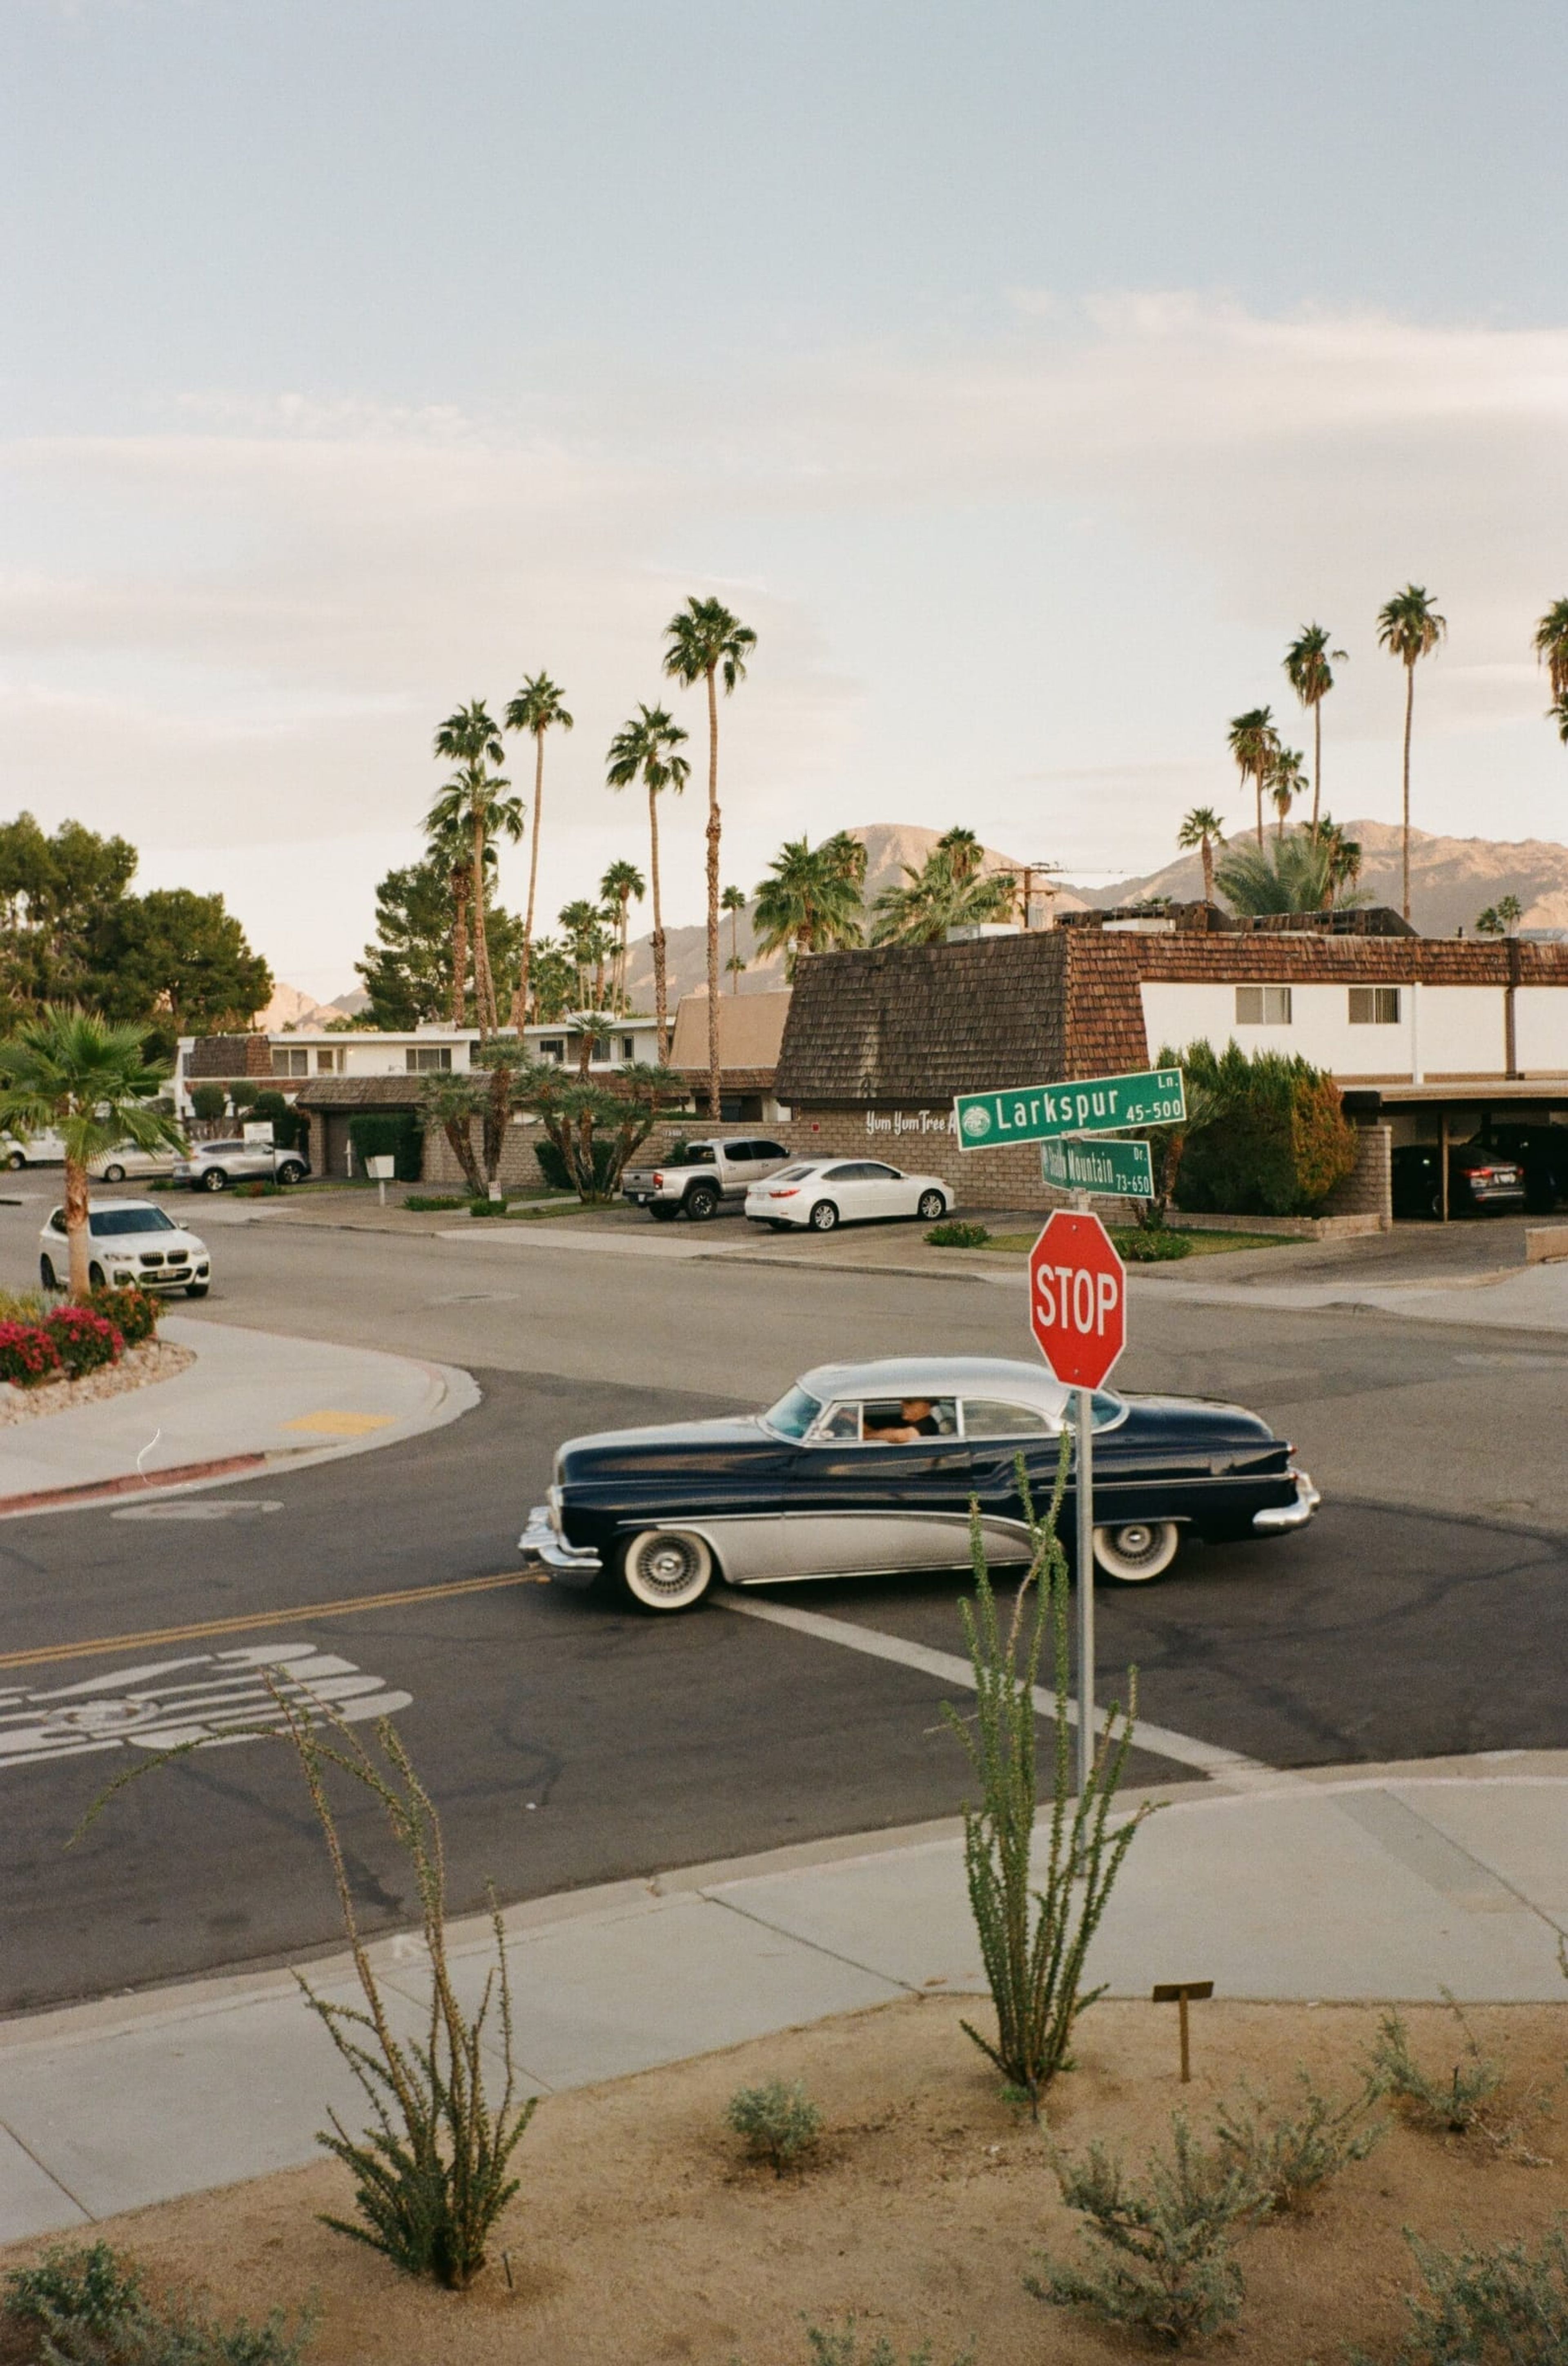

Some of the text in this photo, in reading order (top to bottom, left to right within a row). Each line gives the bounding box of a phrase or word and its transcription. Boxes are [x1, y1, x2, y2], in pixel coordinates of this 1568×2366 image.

[1158, 1075, 1178, 1088] Ln.
[996, 1089, 1118, 1129] Larkspur
[1126, 1099, 1181, 1122] 45-500
[866, 1110, 891, 1135] Yum
[893, 1111, 920, 1136] Yum
[918, 1109, 946, 1135] Tree
[1067, 1148, 1114, 1183] Mountain
[1133, 1146, 1147, 1161] Dr.
[1116, 1173, 1149, 1193] 73-650
[1036, 1264, 1118, 1336] STOP
